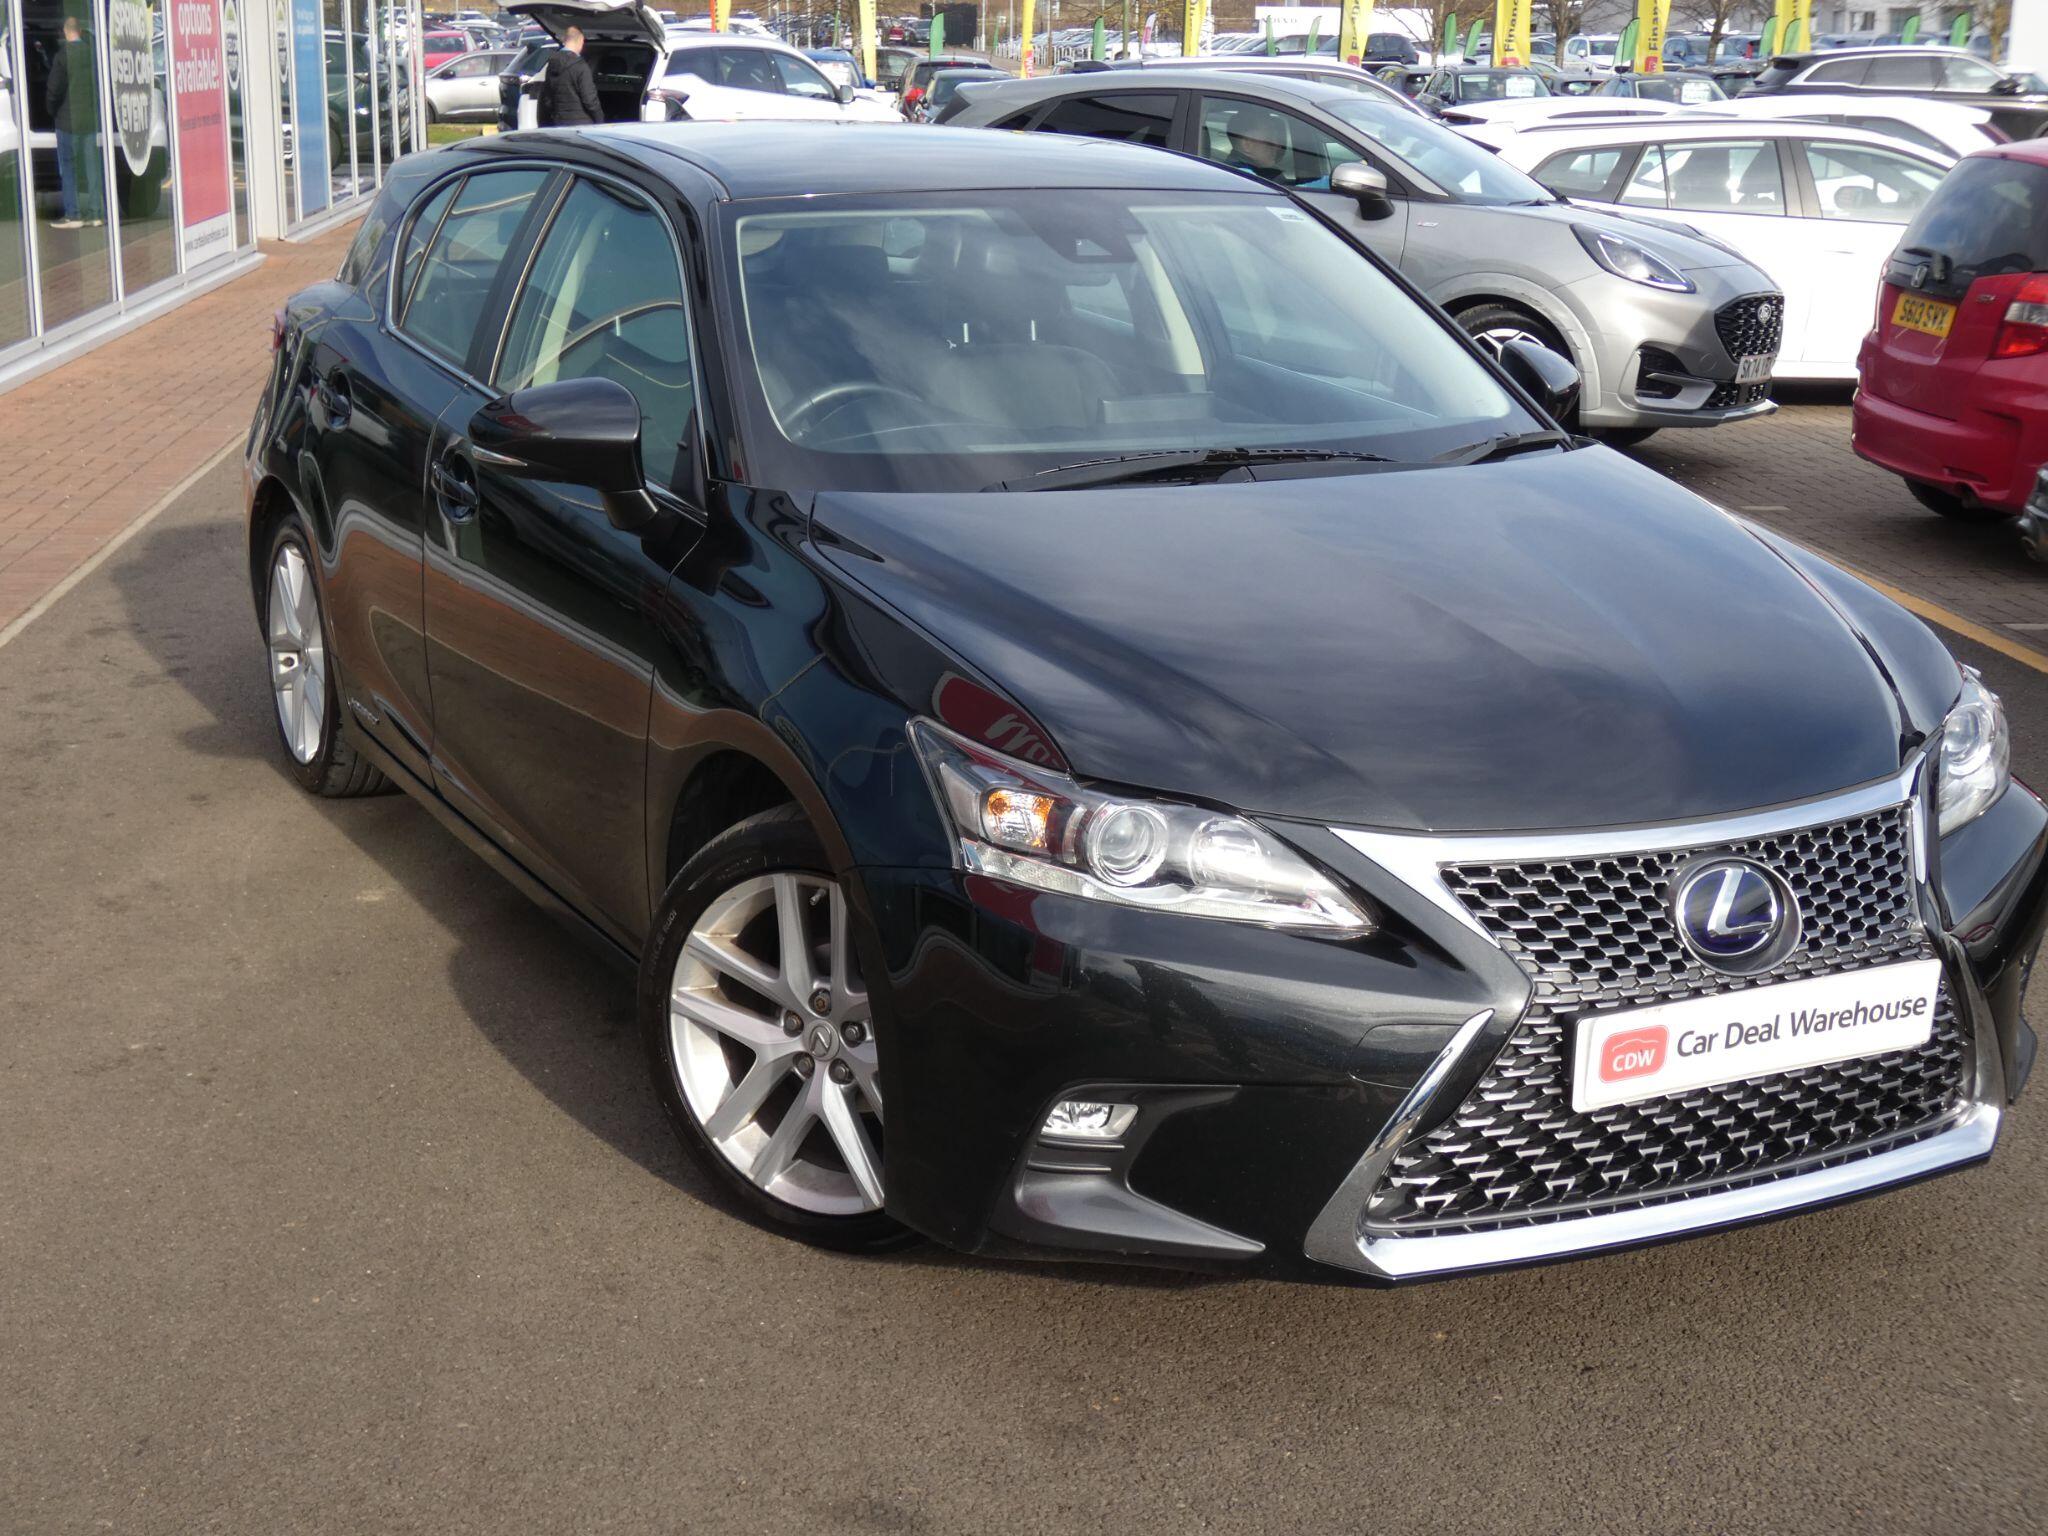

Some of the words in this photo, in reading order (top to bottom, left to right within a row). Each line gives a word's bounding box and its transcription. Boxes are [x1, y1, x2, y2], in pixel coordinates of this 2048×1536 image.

[114, 5, 146, 40] SPRING
[179, 0, 212, 48] options
[1648, 0, 1658, 51] Finan
[111, 49, 134, 84] USED
[177, 48, 219, 94] available!
[121, 92, 148, 132] EVENT
[1677, 1030, 1719, 1057] Car
[1724, 1014, 1780, 1049] Deal
[1790, 997, 1927, 1036] Warehouse
[1612, 1048, 1656, 1072] CDW
